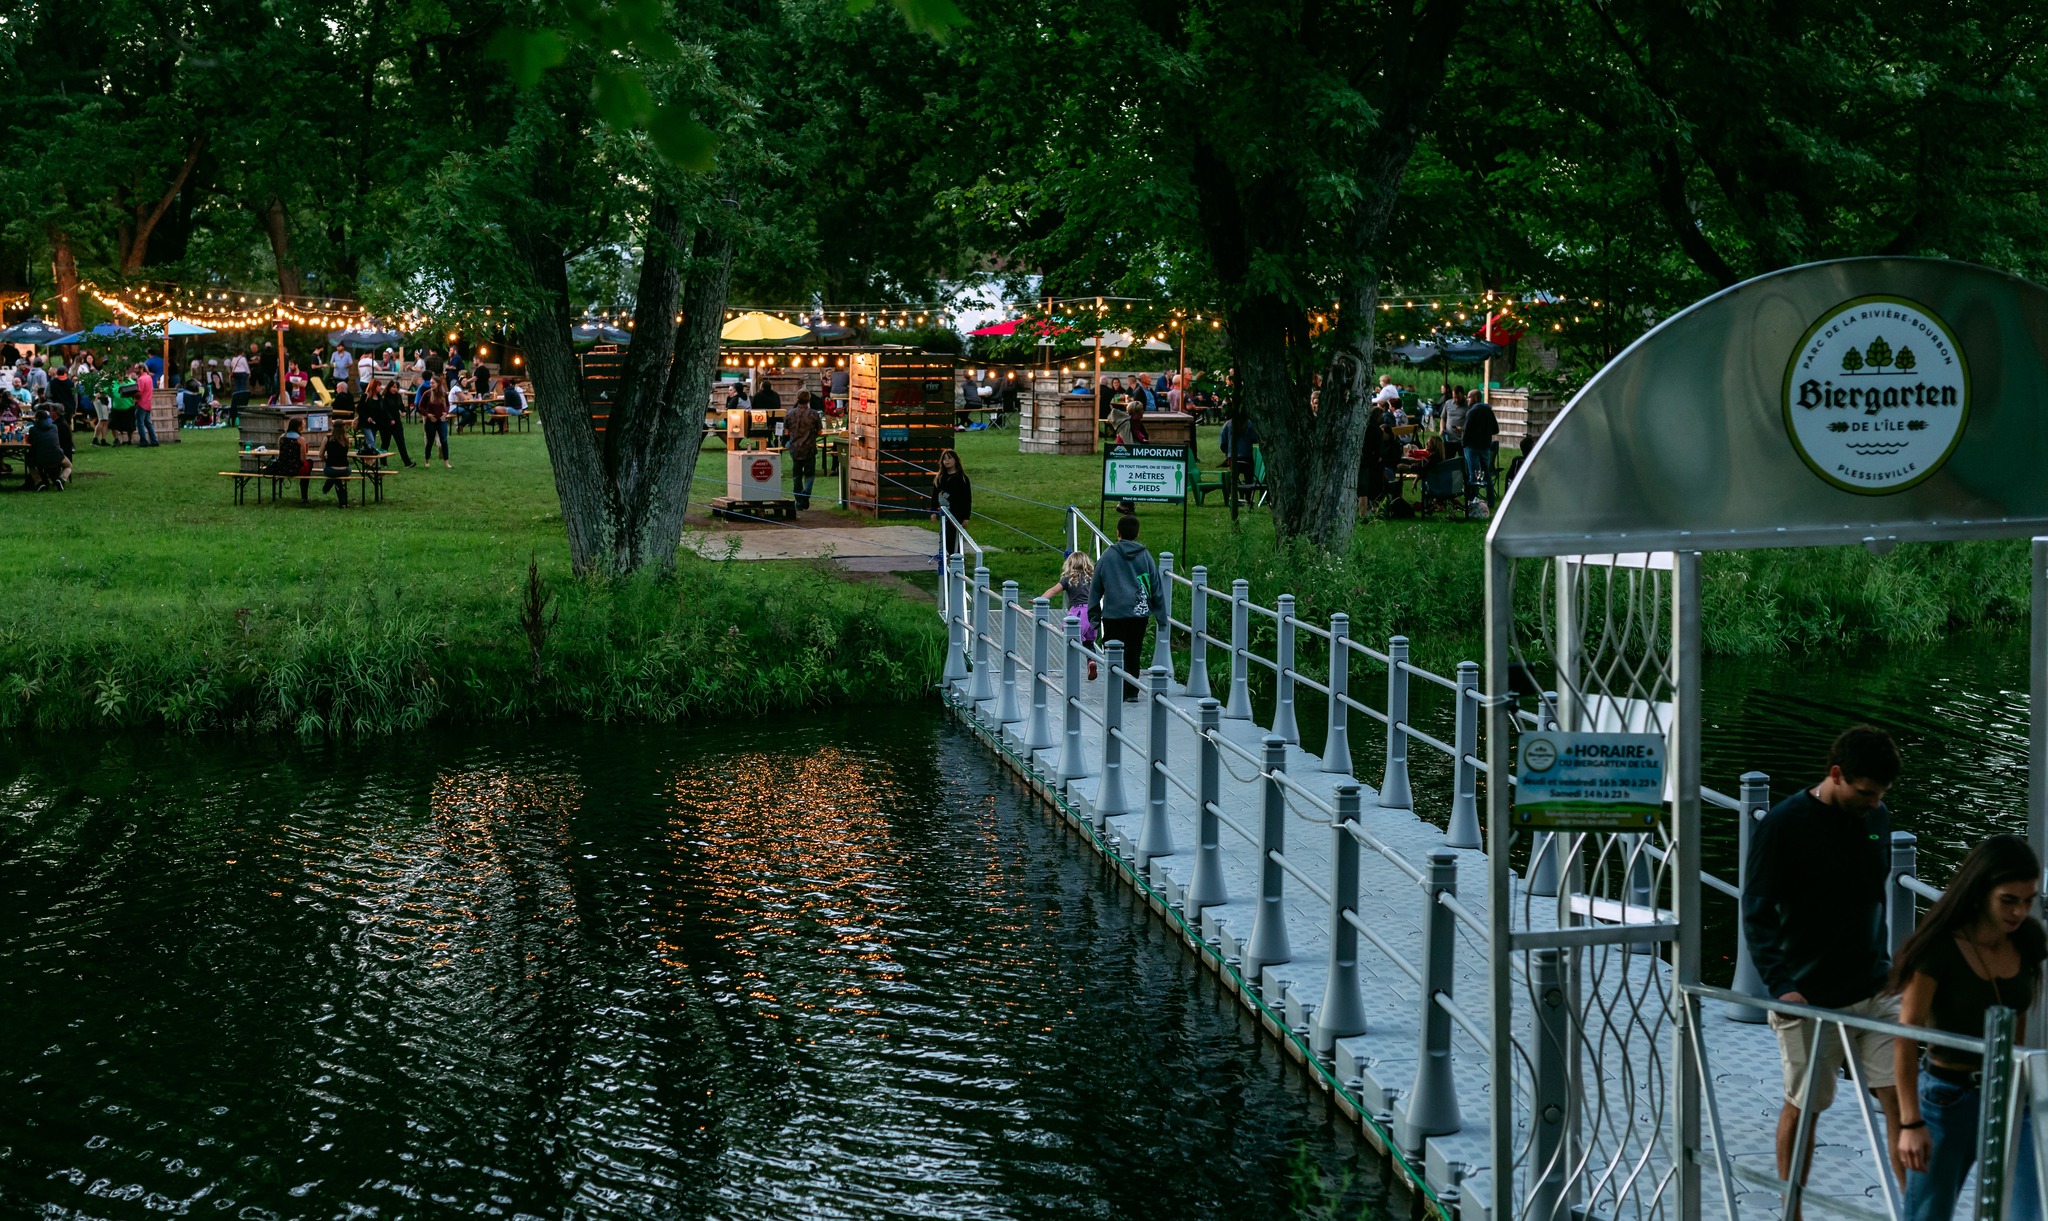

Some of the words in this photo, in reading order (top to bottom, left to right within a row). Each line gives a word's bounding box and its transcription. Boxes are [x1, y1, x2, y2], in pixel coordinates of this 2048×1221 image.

[1803, 339, 1824, 369] PARC
[1825, 324, 1840, 338] DE
[1842, 315, 1857, 327] LA
[1796, 378, 1958, 416] Biergarten
[1851, 421, 1869, 432] DE
[1874, 419, 1905, 431] L'ÎLE
[1132, 447, 1184, 458] IMPORTANT
[1135, 471, 1165, 480] MÈTRES
[1837, 462, 1916, 481] PLESSISVILLE
[1575, 745, 1645, 758] HORAIRE
[1574, 759, 1625, 768] BIERGARTEN
[1628, 760, 1639, 768] DE
[1559, 778, 1596, 787] vendredi
[1599, 779, 1609, 787] 16
[1611, 779, 1617, 787] h
[1619, 779, 1630, 787] 30
[1639, 779, 1649, 787] 23
[1651, 779, 1657, 787] h
[1550, 789, 1582, 798] Samedi
[1584, 790, 1594, 798] 14
[1596, 790, 1602, 798] h
[1604, 790, 1609, 798] à
[1612, 790, 1622, 798] 23
